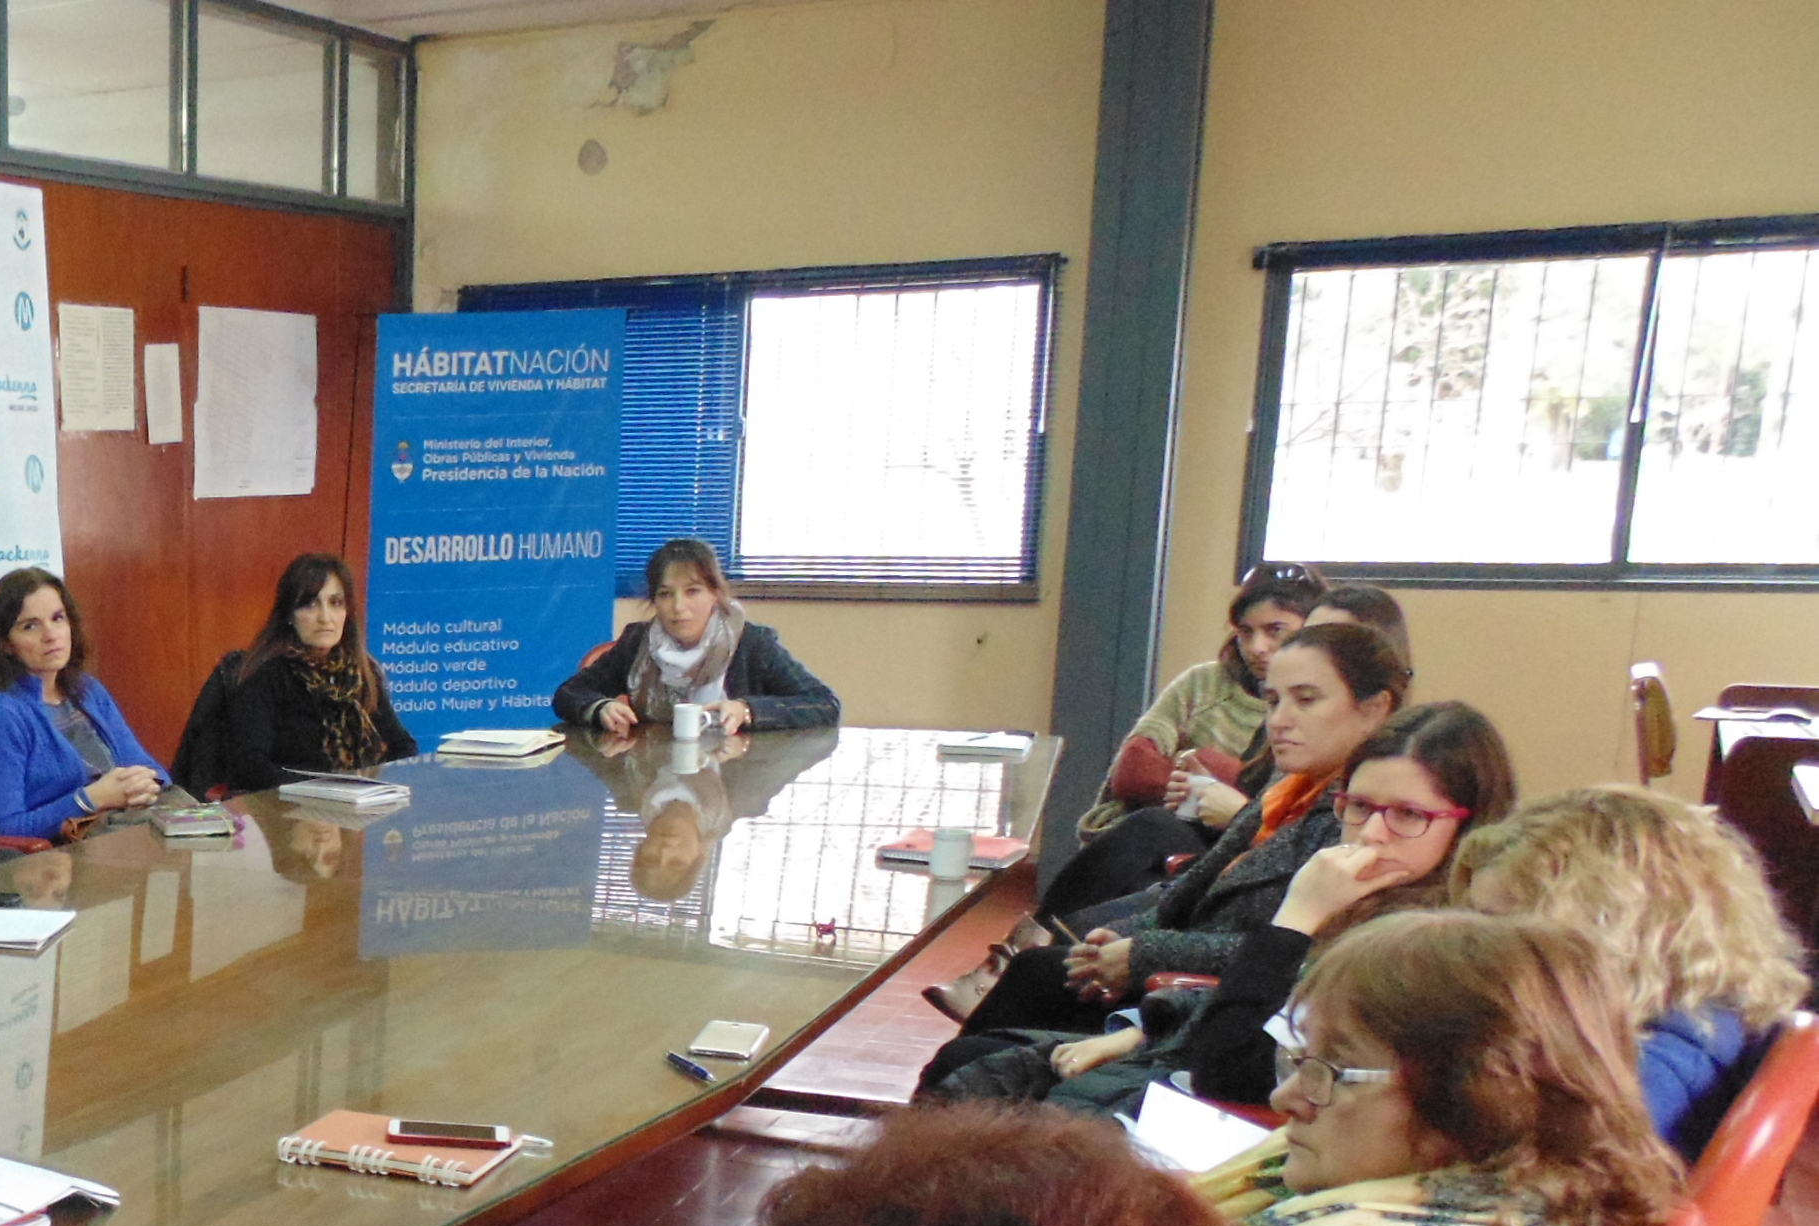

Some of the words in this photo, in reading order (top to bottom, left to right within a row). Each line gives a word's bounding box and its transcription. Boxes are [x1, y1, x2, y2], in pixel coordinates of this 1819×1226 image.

[392, 379, 466, 395] SECRETARÍA
[469, 380, 485, 393] DE
[487, 379, 543, 392] VIVIENDA
[546, 379, 554, 390] Y
[556, 376, 608, 390] HÁBITAT
[423, 439, 481, 451] Ministerio
[485, 437, 503, 449] del
[423, 453, 458, 465] Obras
[462, 451, 510, 464] Públicas
[513, 452, 522, 464] y
[524, 450, 575, 462] Vivienda
[422, 467, 508, 482] Presidencia
[512, 465, 531, 479] de
[535, 464, 548, 478] la
[552, 463, 605, 478] Nación
[385, 533, 514, 565] DESARROLLO
[518, 531, 603, 560] HUMANO
[383, 621, 440, 636] Módulo
[444, 618, 502, 634] cultural
[382, 640, 439, 655] Módulo
[444, 639, 520, 653] educativo
[381, 659, 439, 674] Módulo
[442, 658, 487, 672] verde
[442, 677, 518, 694] deportivo
[391, 697, 438, 713] ódulo
[441, 696, 484, 714] Mujer
[488, 699, 497, 711] y
[501, 694, 553, 708] Hábita
